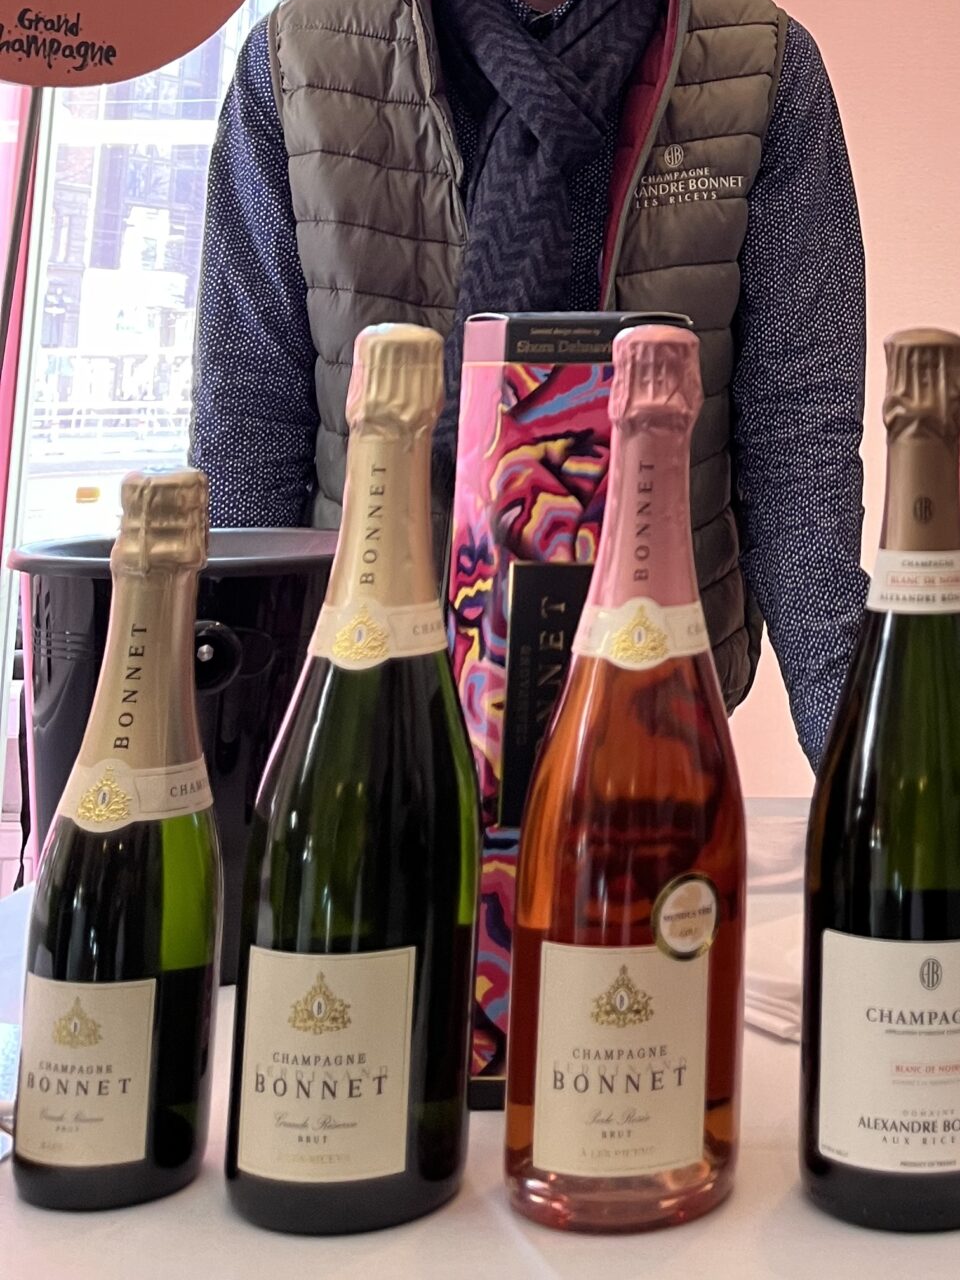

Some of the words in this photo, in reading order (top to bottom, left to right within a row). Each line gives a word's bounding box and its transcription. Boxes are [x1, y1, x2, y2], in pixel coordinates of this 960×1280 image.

[17, 8, 80, 36] Grand
[0, 23, 117, 72] hampagne
[641, 167, 710, 184] CHAMPAGNE
[634, 181, 685, 198] ANDRE
[689, 176, 744, 191] BONNET
[636, 198, 658, 209] LES
[669, 191, 718, 203] RICEYS
[360, 464, 387, 586] BONNET
[634, 460, 656, 582] BONNET
[535, 596, 567, 755] NNET
[113, 623, 148, 751] BONNET
[272, 1052, 367, 1067] CHAMPAGNE
[572, 1045, 668, 1061] CHAMPAGNE
[39, 1061, 114, 1075] CHAMPAGNE
[895, 1064, 922, 1075] BLANC
[27, 1072, 132, 1097] BONNET
[254, 1073, 389, 1100] BONNET
[553, 1065, 687, 1094] BONNET
[601, 1129, 633, 1140] BRUT
[857, 1116, 939, 1134] ALEXANDRE
[297, 1135, 328, 1144] BRUT
[882, 1135, 910, 1145] AUX
